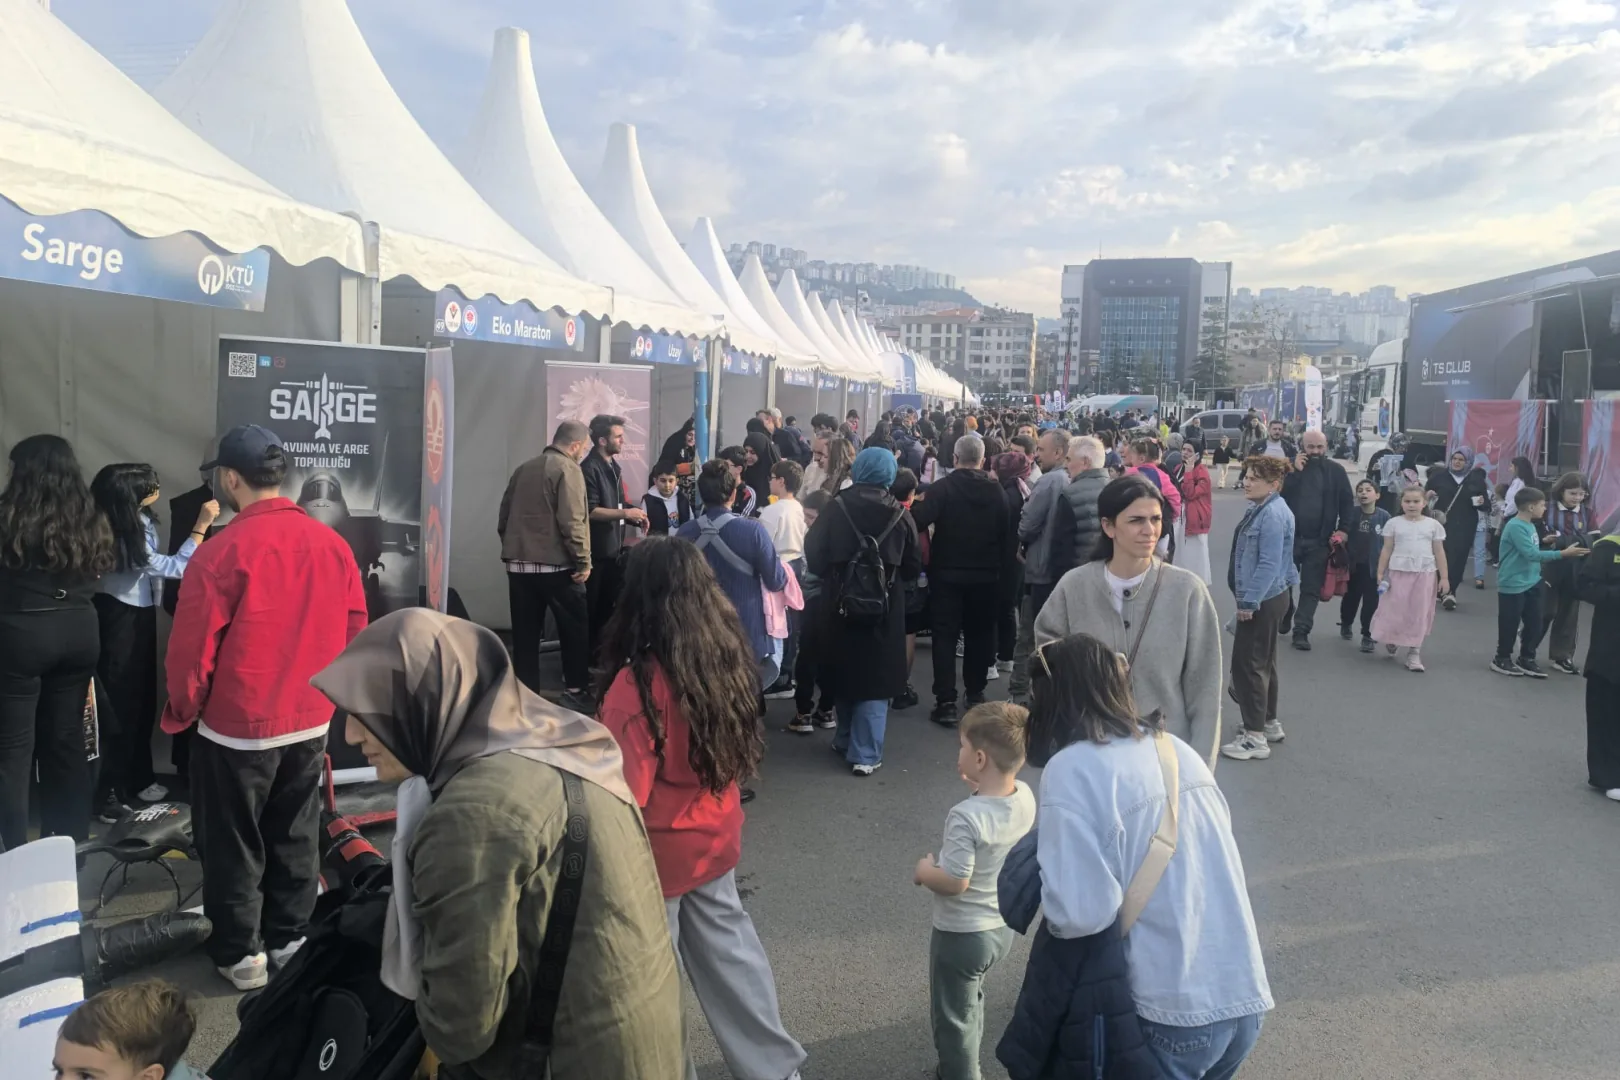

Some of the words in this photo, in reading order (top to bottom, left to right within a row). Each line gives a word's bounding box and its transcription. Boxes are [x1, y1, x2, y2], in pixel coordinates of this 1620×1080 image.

[21, 223, 124, 281] Sarge
[226, 264, 254, 286] KTÜ
[492, 316, 511, 335] Eko
[514, 319, 551, 341] Maraton
[1433, 362, 1445, 374] TS
[1446, 361, 1471, 373] CLUB
[270, 388, 376, 427] SARGE
[282, 442, 326, 453] AVUNMA
[328, 443, 341, 454] VE
[343, 444, 370, 454] ARGE
[294, 456, 351, 468] TOPLULUĞU
